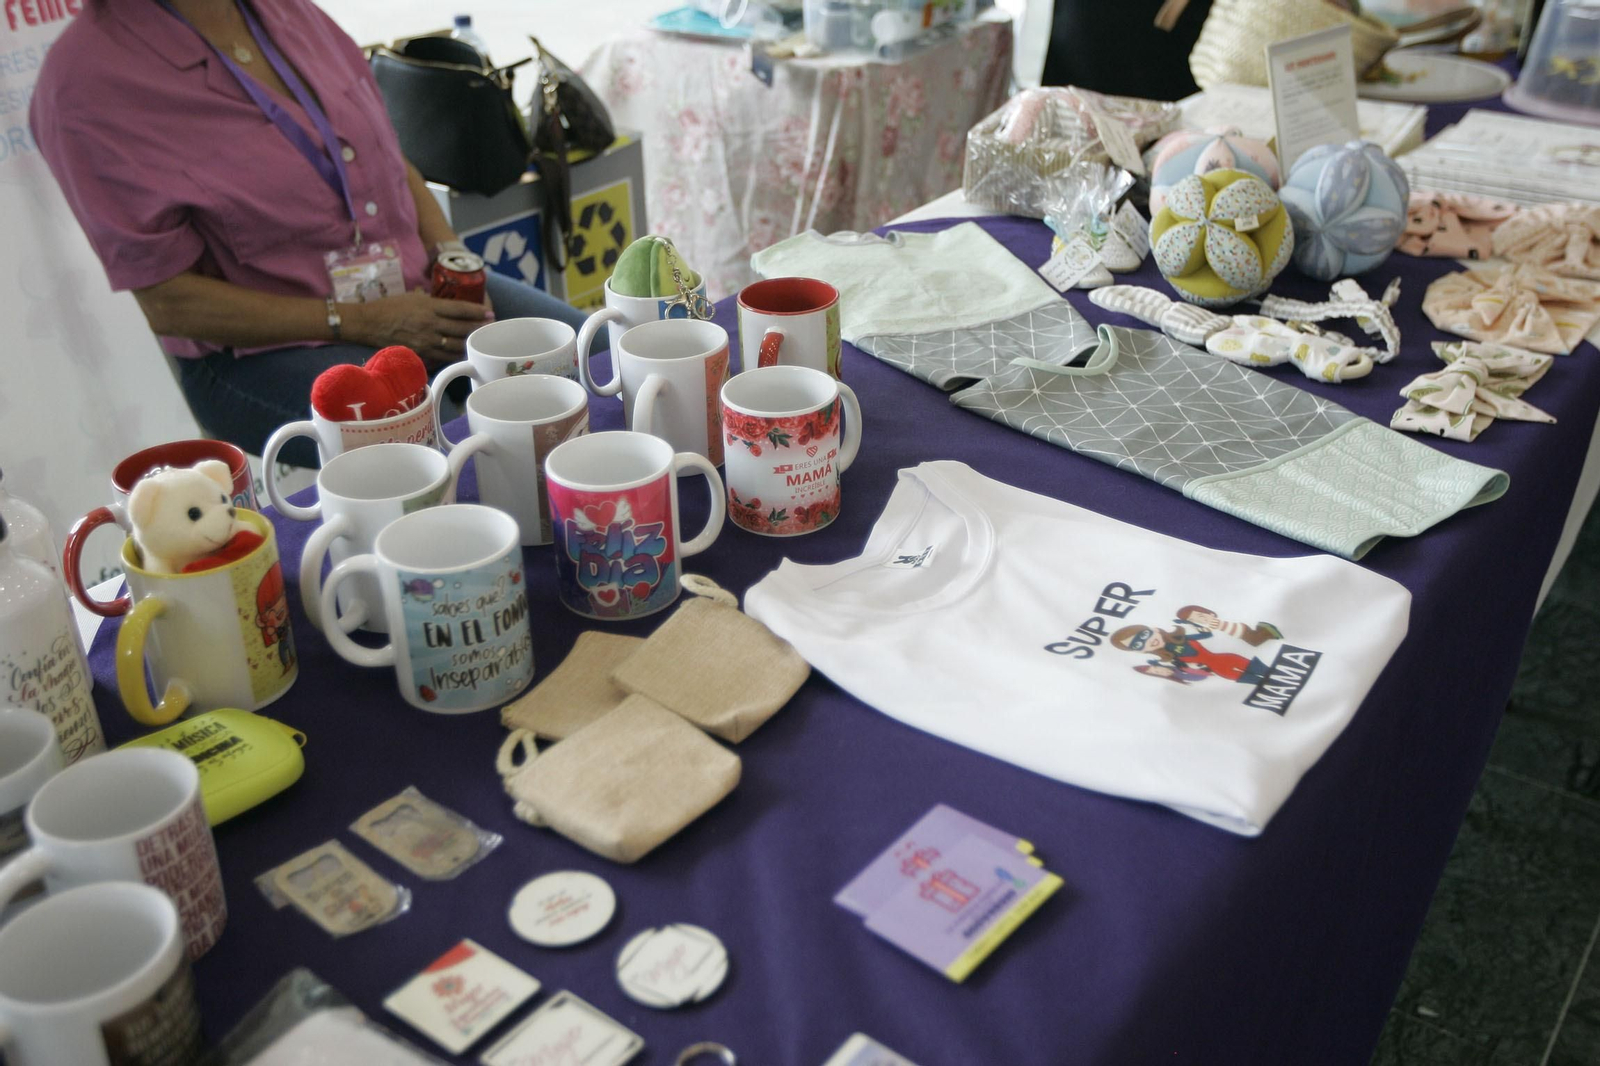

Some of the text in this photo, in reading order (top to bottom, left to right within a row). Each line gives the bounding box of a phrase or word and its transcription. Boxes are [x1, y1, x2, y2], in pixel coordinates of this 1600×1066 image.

[786, 459, 832, 487] MAMÁ
[422, 621, 454, 649] EN
[460, 618, 487, 647] EL
[1043, 581, 1158, 660] SUPER
[1250, 651, 1318, 710] MAMA
